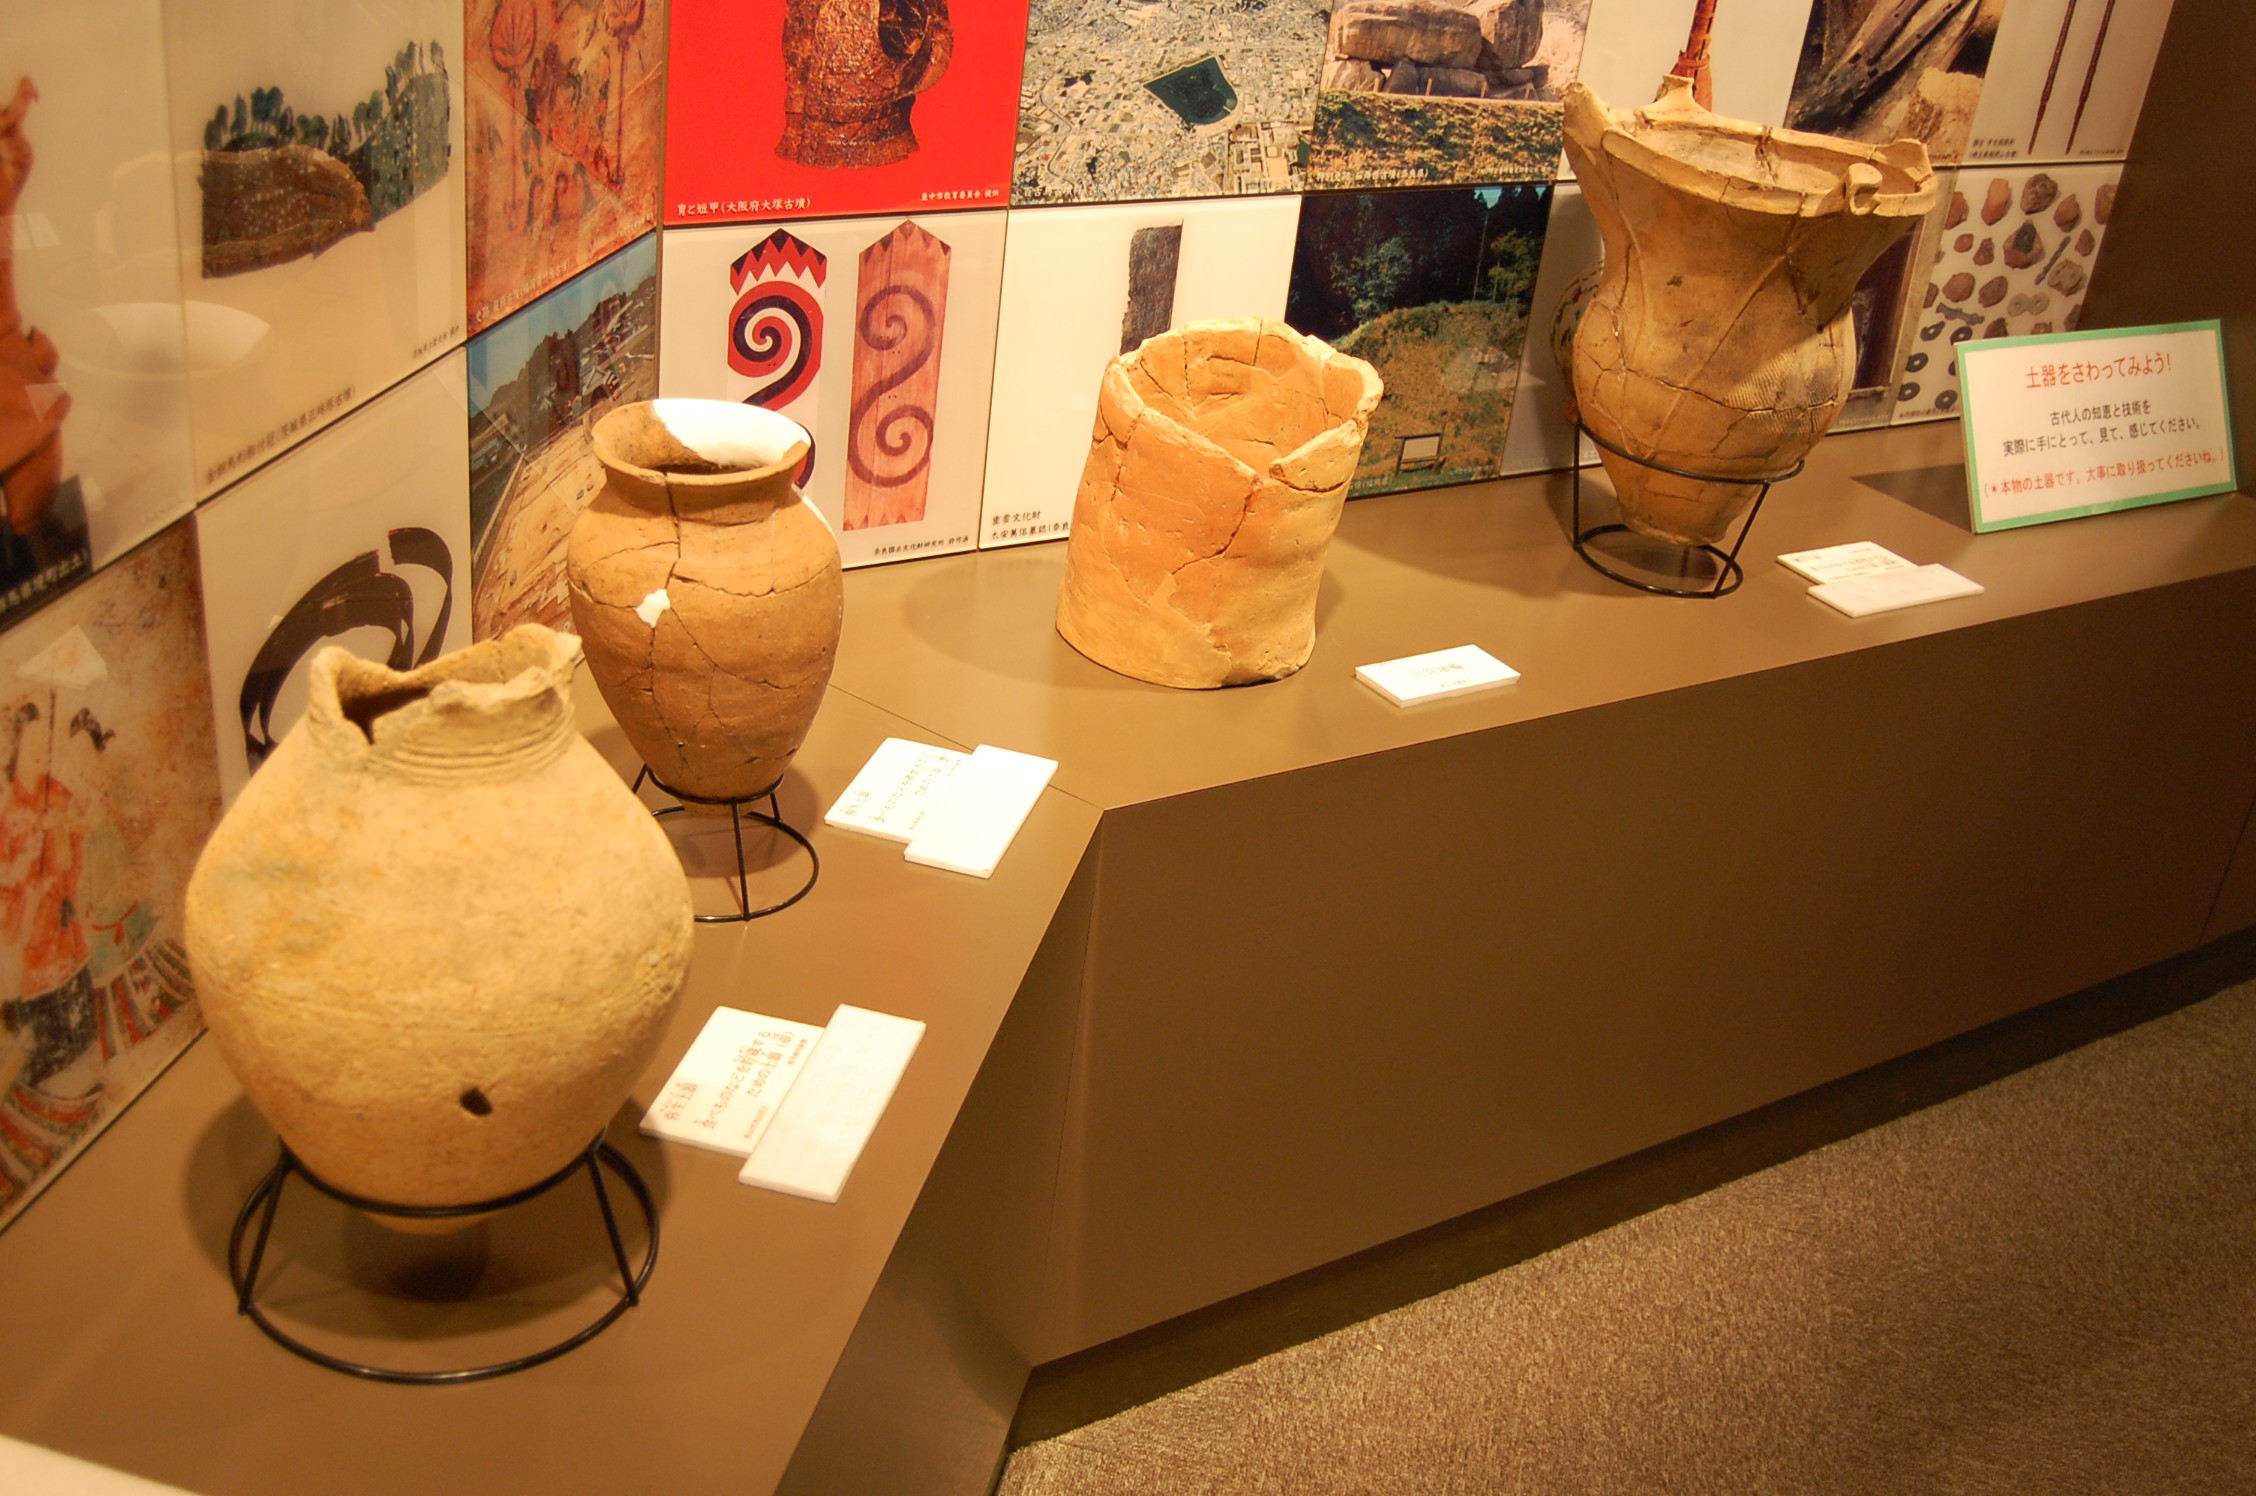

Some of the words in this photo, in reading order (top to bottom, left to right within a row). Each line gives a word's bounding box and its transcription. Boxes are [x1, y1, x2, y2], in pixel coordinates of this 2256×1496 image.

[2025, 353, 2171, 389] 土器をさわってみよう！
[2050, 400, 2151, 426] 古代人の知恵と技術を
[2003, 418, 2201, 456] 実際に手にとって、見て、感じてください。
